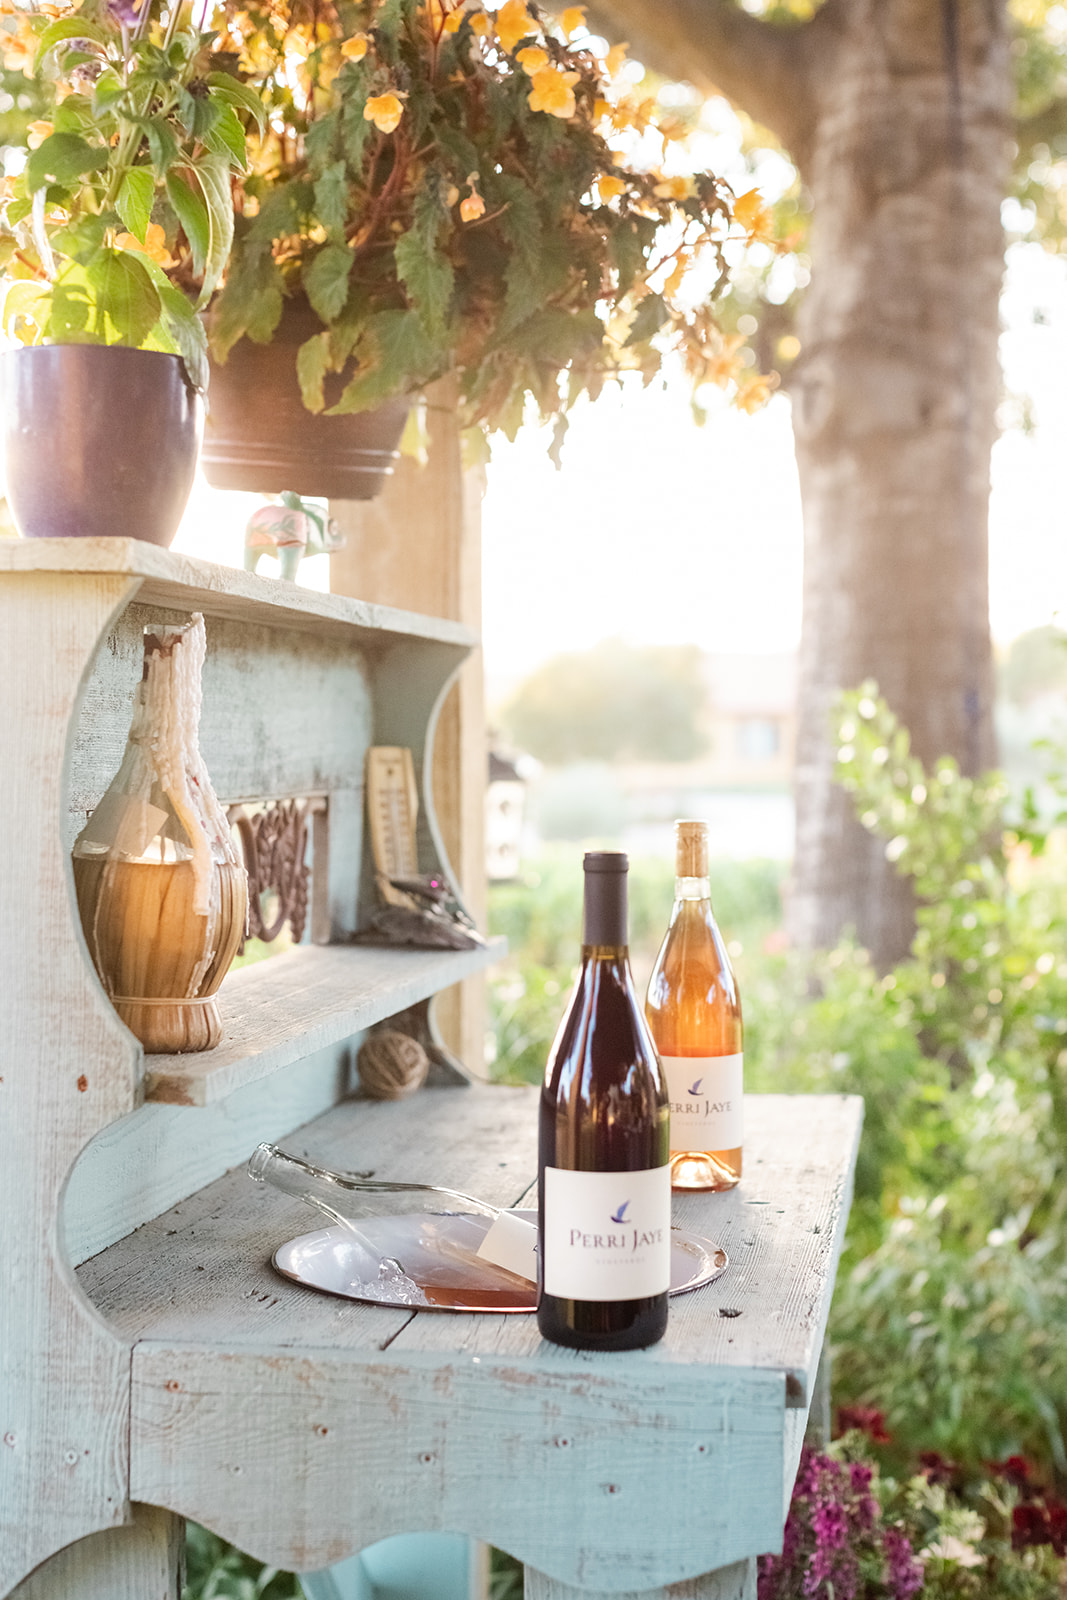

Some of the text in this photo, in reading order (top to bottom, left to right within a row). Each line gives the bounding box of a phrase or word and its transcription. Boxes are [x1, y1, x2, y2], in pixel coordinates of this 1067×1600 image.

[669, 1099, 732, 1118] ERRI JAYE
[569, 1228, 664, 1253] PERRI JAYE
